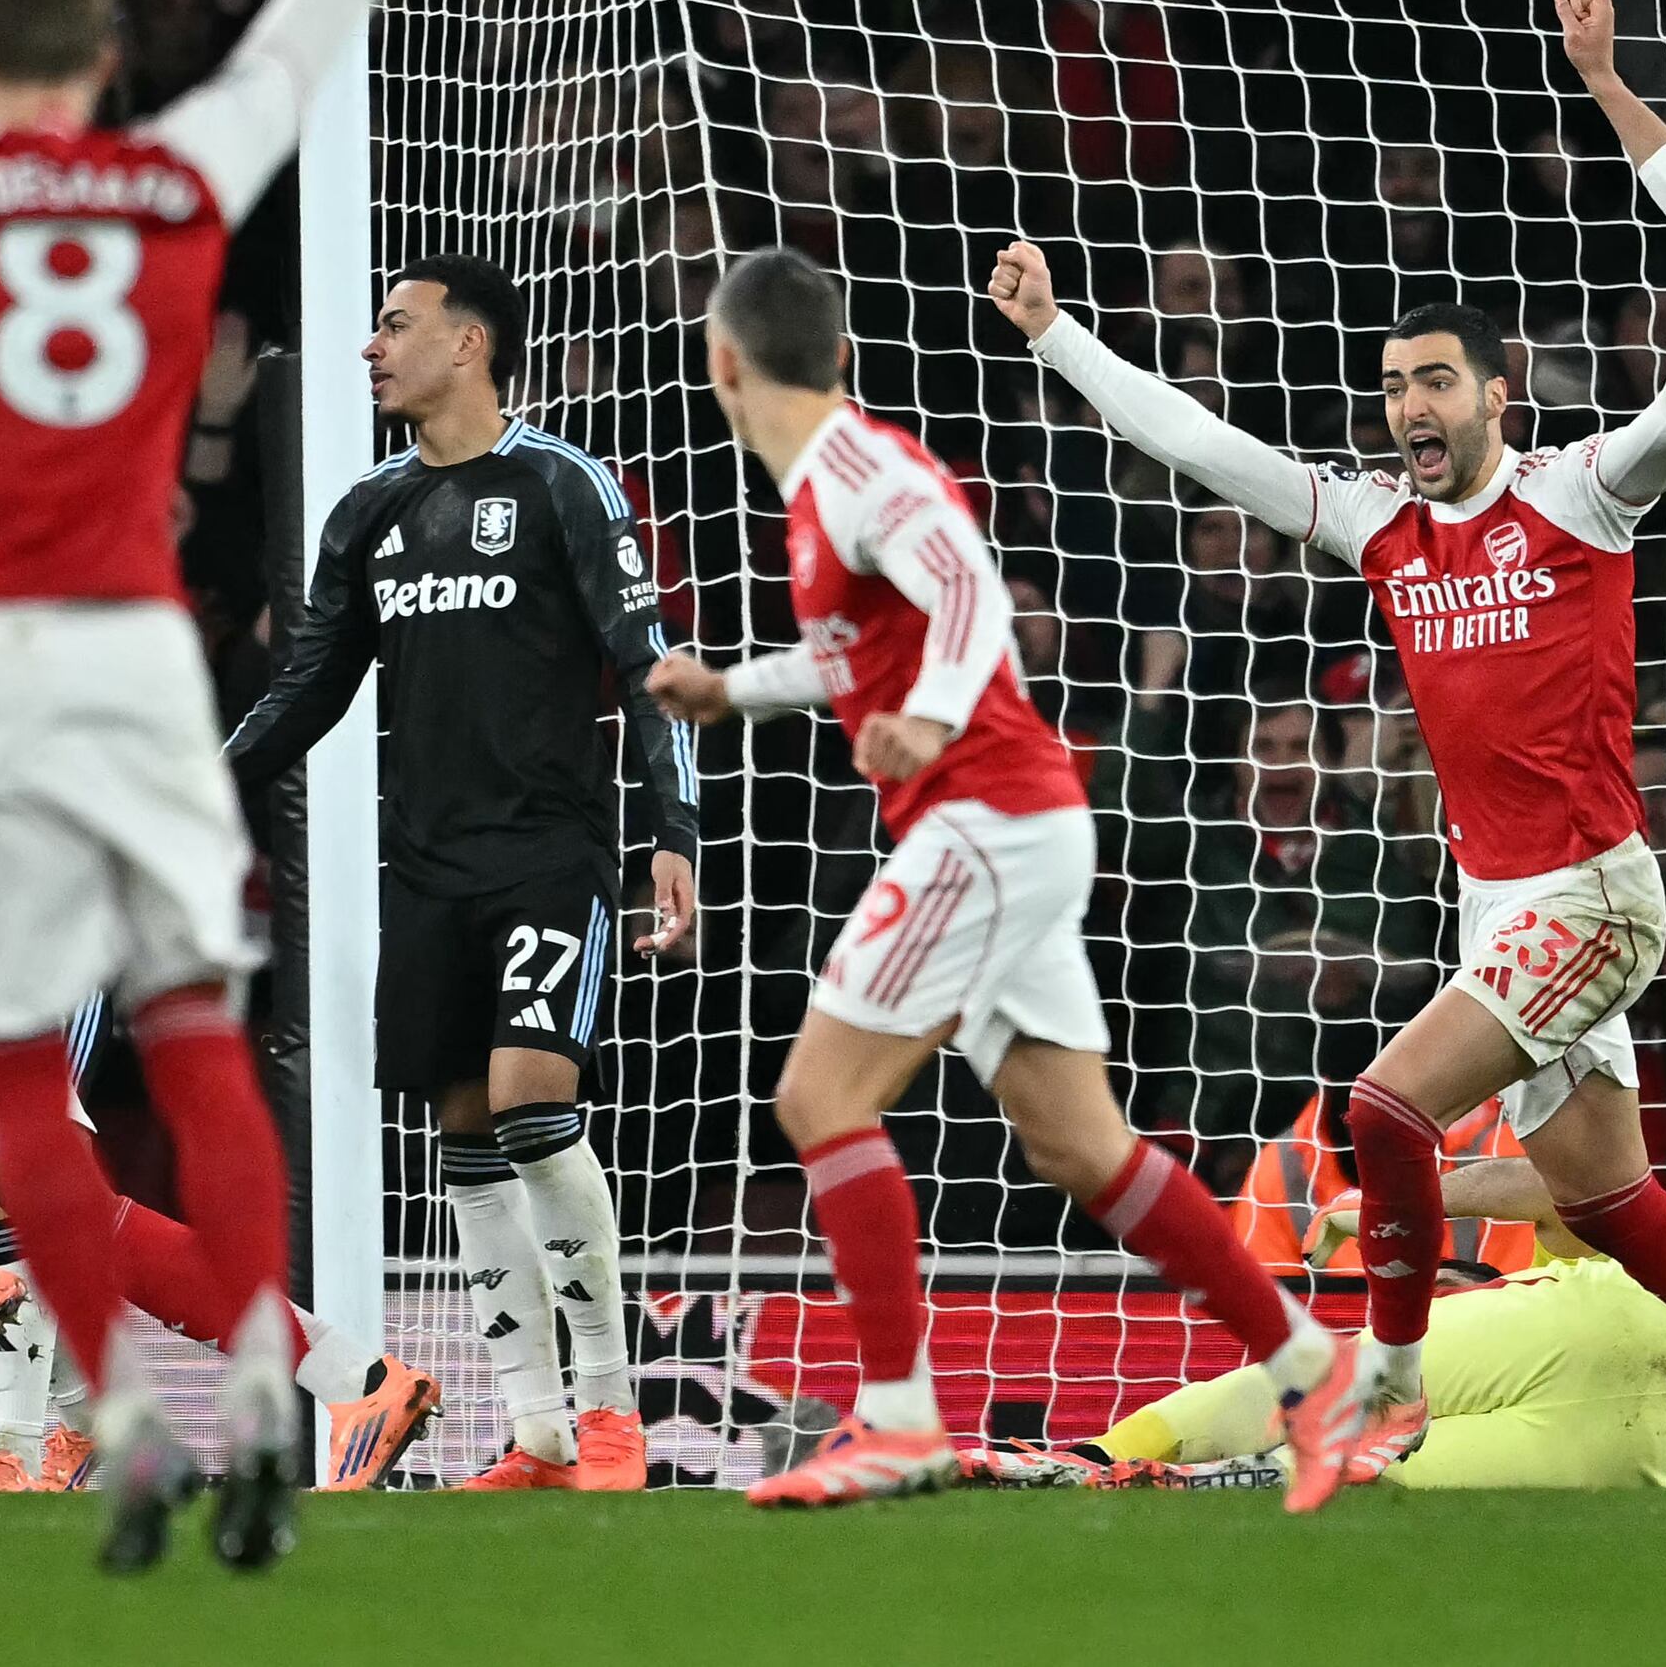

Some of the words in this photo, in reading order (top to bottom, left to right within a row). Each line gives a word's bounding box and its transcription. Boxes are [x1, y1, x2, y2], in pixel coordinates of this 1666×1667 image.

[374, 572, 517, 623] Betano
[1383, 566, 1557, 618] Emirates
[1414, 618, 1446, 654] FLY
[1451, 606, 1530, 651] BETTER
[501, 924, 582, 994] 27
[1491, 910, 1581, 978] 23
